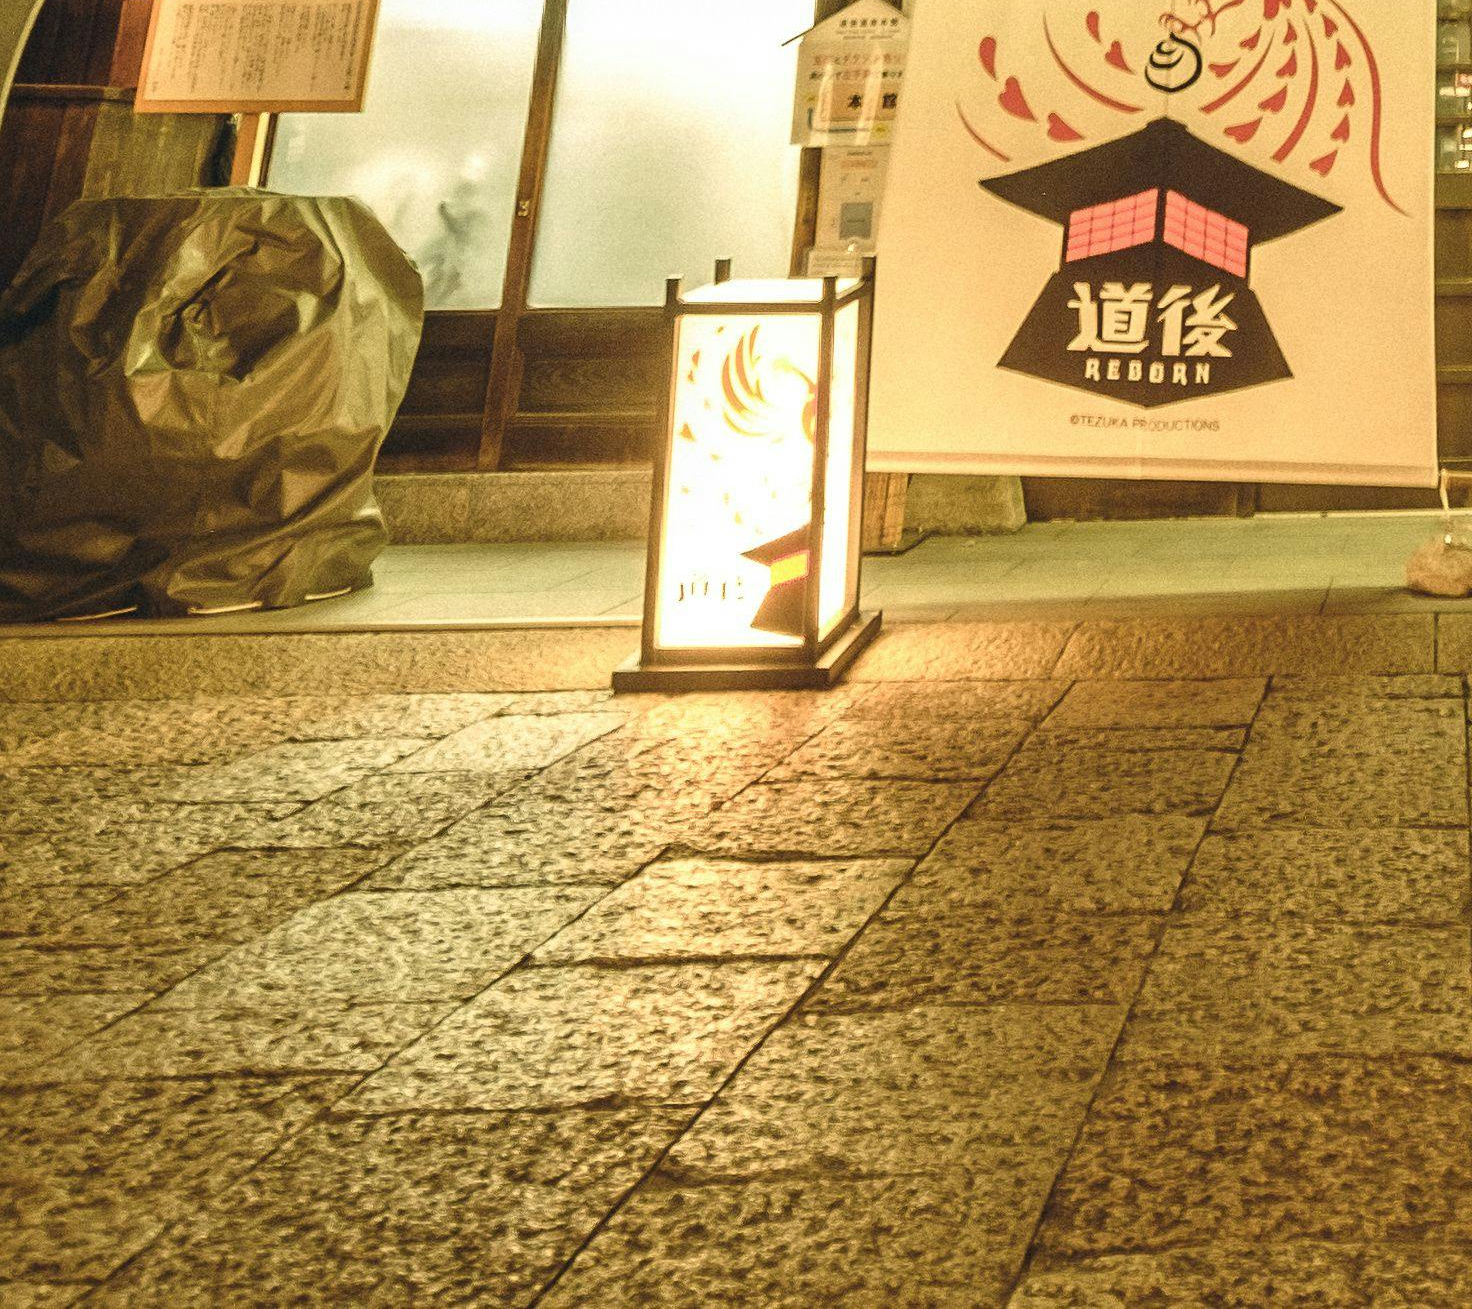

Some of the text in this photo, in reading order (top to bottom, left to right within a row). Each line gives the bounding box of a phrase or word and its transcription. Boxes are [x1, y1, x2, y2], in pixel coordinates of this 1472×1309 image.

[1066, 281, 1239, 358] 道後
[1084, 357, 1211, 387] REBORN
[1131, 416, 1221, 433] PRODUCTIONS
